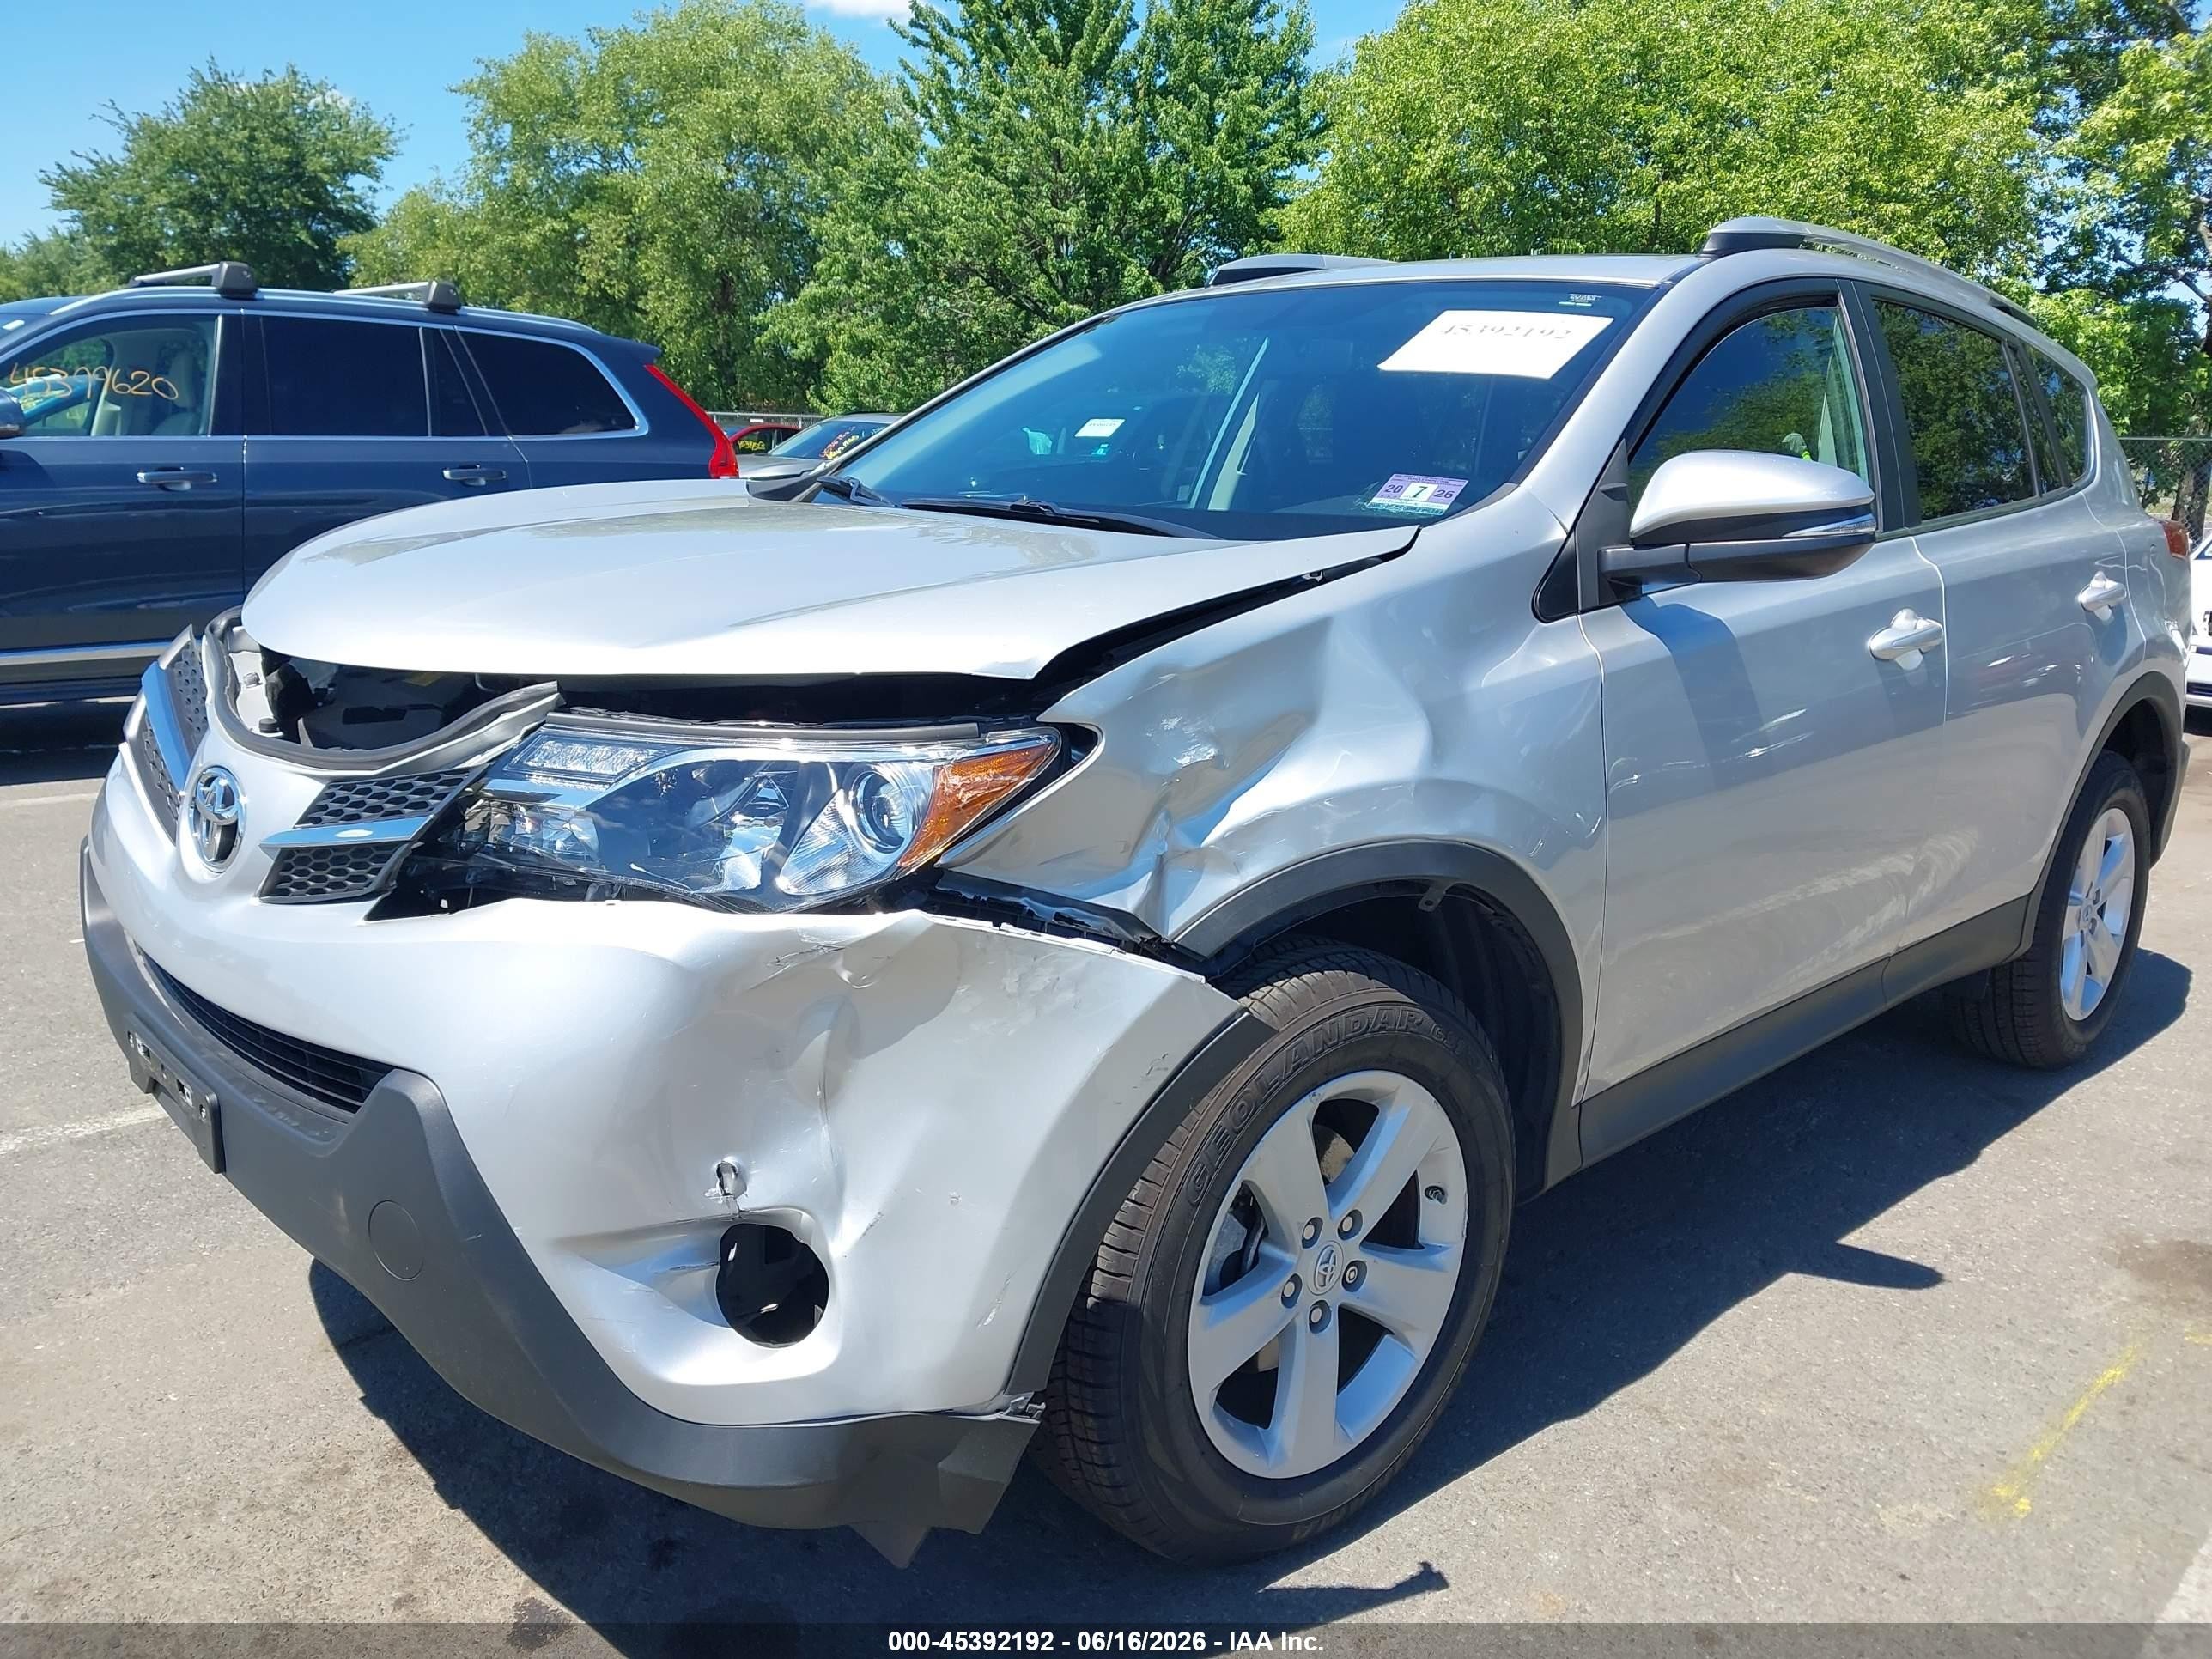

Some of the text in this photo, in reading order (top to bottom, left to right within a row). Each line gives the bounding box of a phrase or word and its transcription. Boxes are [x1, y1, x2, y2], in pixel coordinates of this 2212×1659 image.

[1383, 484, 1455, 499] 20 7 26
[1185, 1005, 1428, 1206] GEOLANDAR
